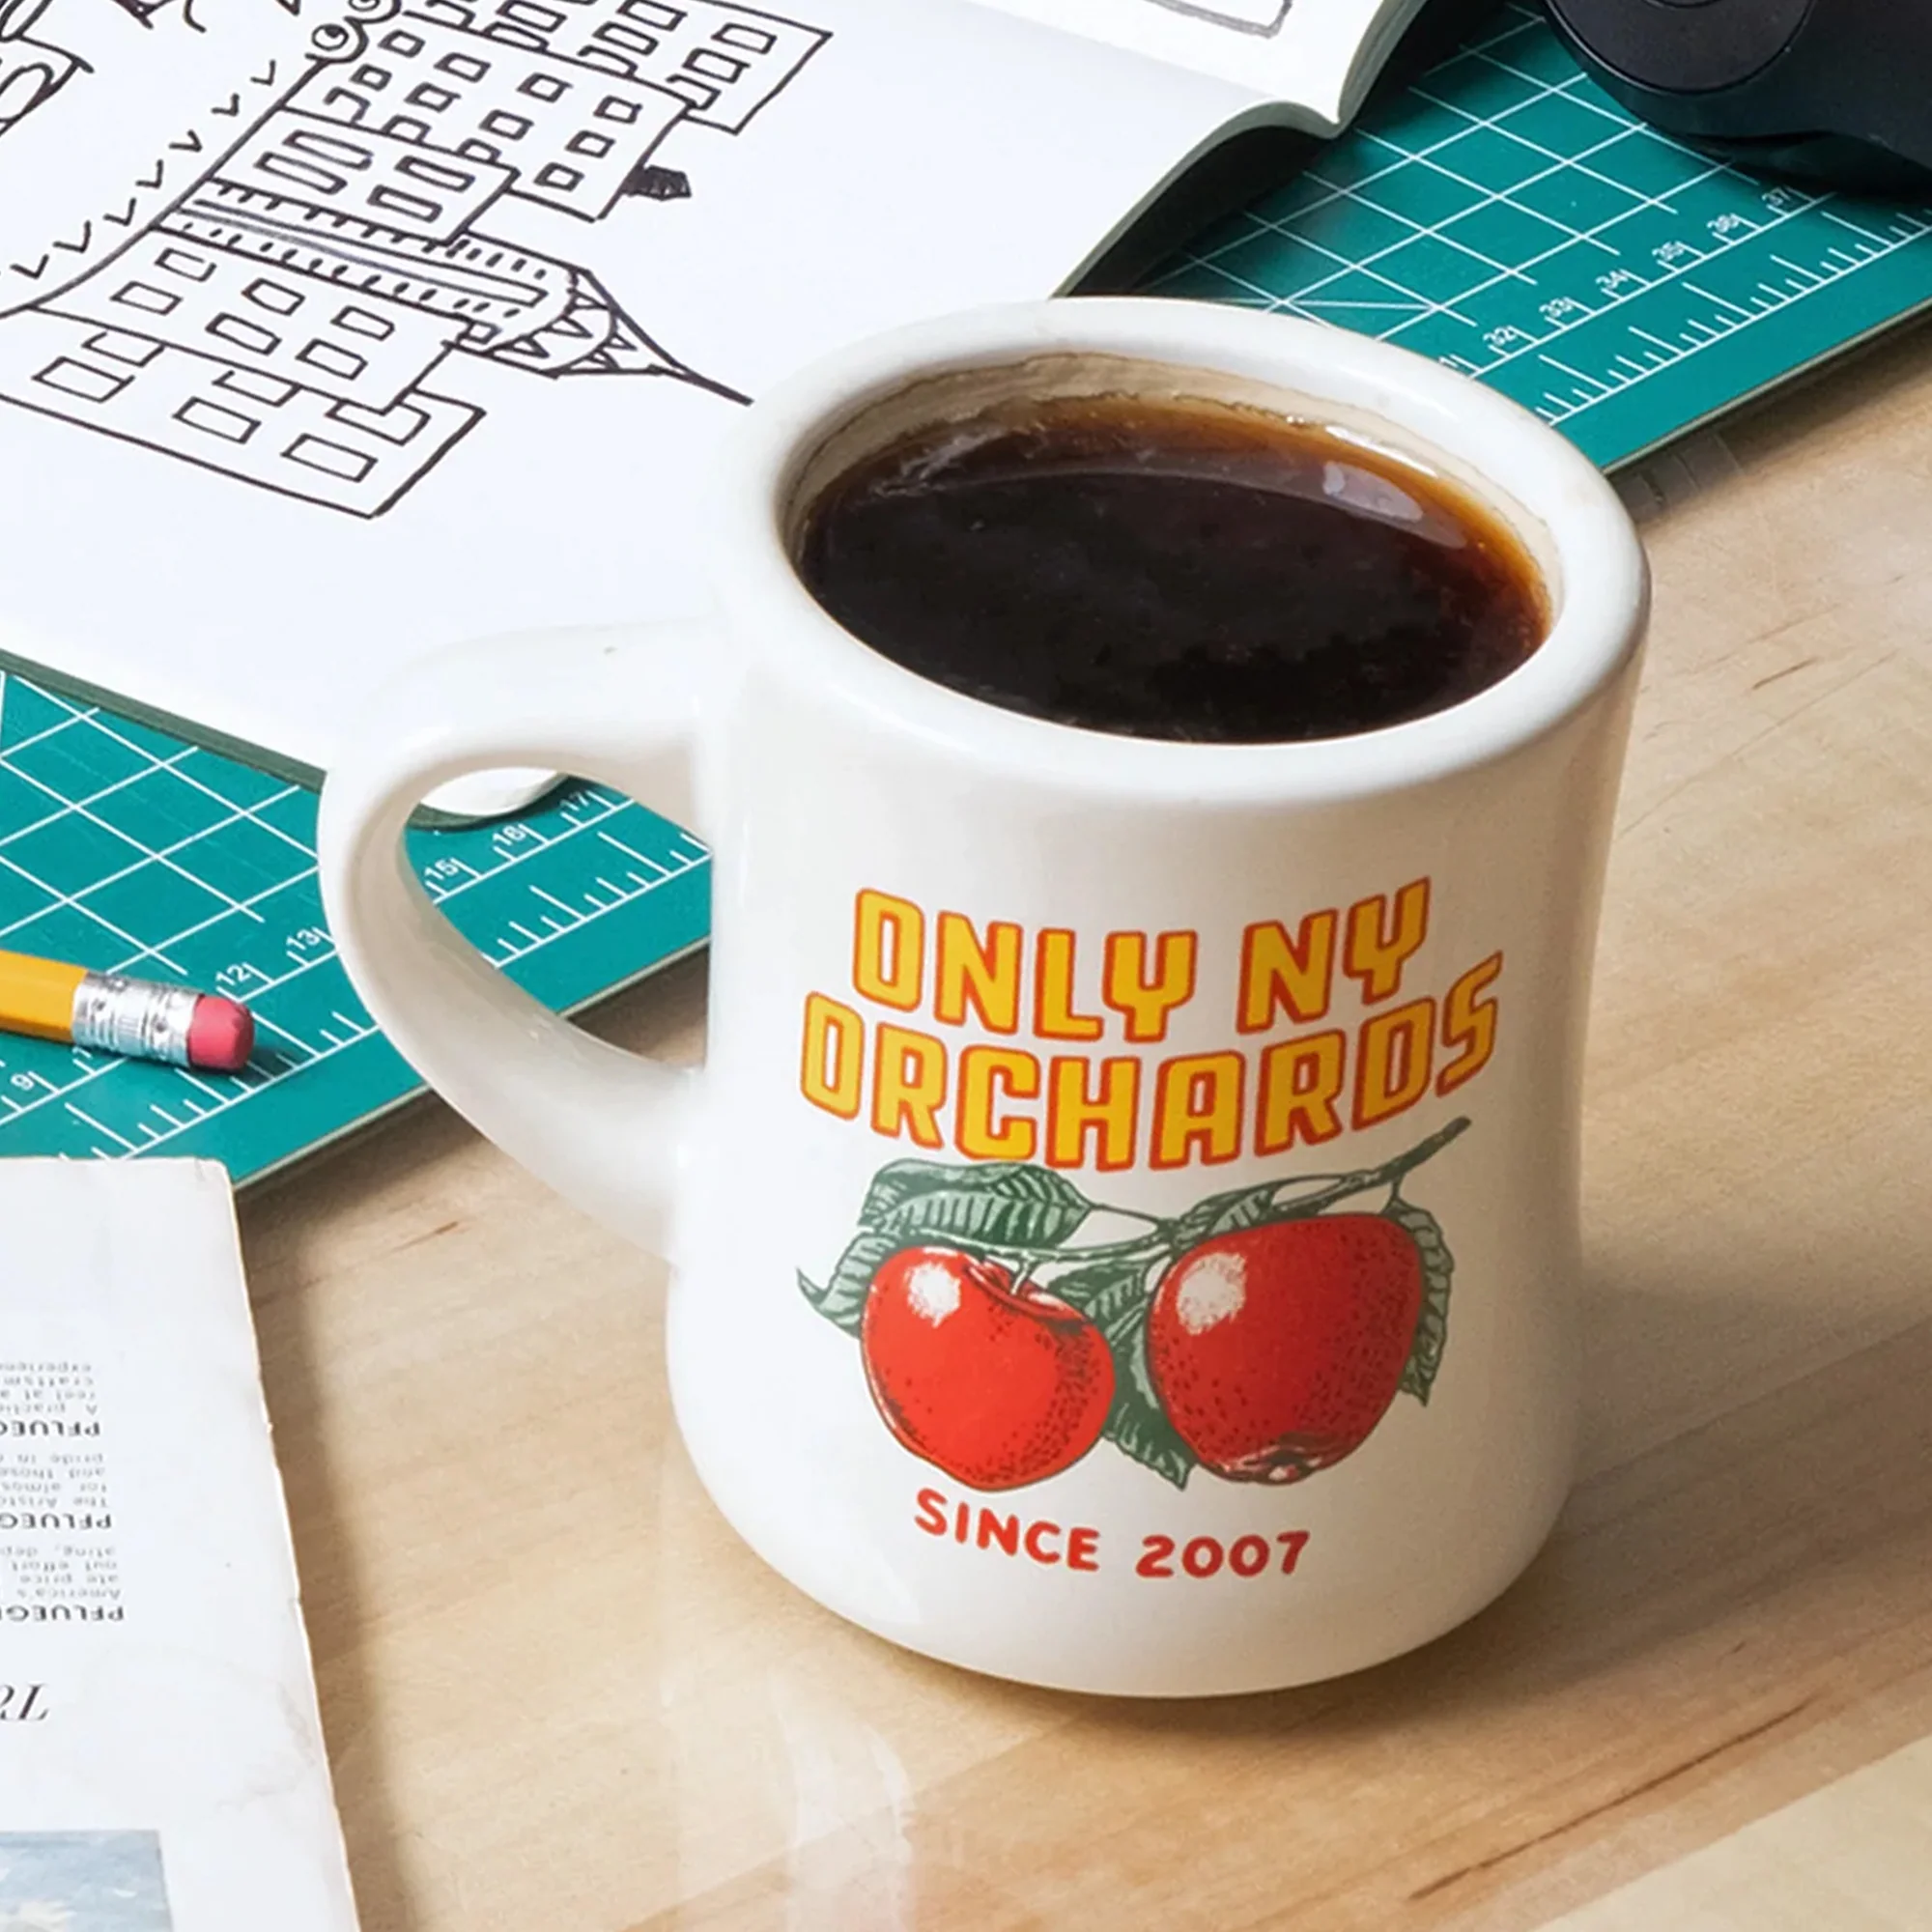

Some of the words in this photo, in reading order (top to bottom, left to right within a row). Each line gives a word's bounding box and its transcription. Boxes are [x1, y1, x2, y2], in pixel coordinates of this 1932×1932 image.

[1483, 327, 1517, 346] 32
[1539, 298, 1573, 318] 33
[1596, 270, 1628, 290] 34
[1652, 242, 1685, 261] 35
[1761, 187, 1791, 206] 37
[424, 858, 459, 880] 15
[560, 792, 589, 811] 17
[215, 964, 251, 985] 12
[286, 929, 321, 951] 13
[852, 887, 1198, 1042] ONLY
[1236, 875, 1431, 1035] NY
[800, 951, 1503, 1172] ORCHARDS
[914, 1488, 1100, 1573] SINCE
[1135, 1529, 1311, 1578] 2007
[0, 1604, 124, 1623] PFLUEG
